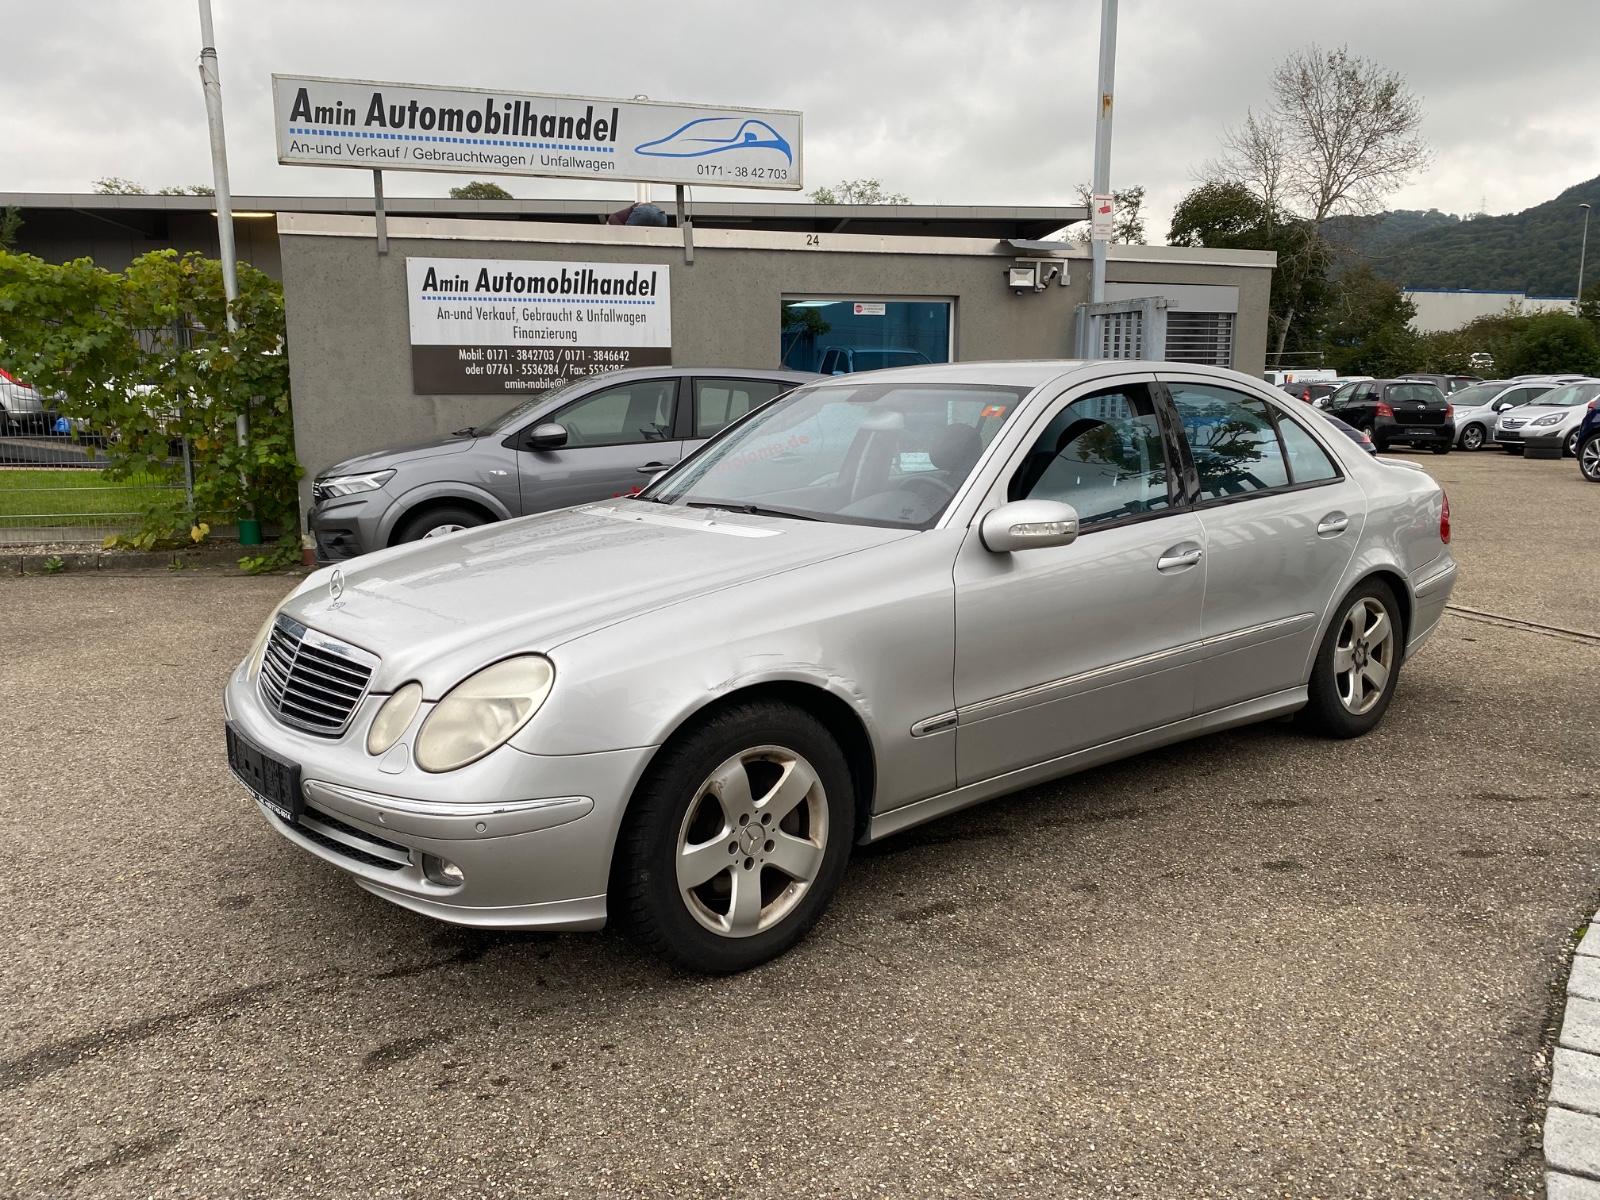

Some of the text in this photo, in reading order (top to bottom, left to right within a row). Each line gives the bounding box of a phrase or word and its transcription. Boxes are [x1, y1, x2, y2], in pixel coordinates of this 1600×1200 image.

[289, 87, 619, 142] Amin Automobilhandel
[290, 140, 342, 155] An-und
[346, 143, 401, 159] Verkauf
[412, 147, 526, 167] Gebrauchtwagen
[540, 155, 615, 172] Unfallwagen
[696, 164, 723, 176] 0171
[734, 167, 748, 178] 38
[751, 167, 764, 179] 42
[767, 168, 788, 180] 703
[806, 234, 820, 246] 24
[421, 266, 657, 297] Amin Automobilhandel
[436, 305, 647, 326] An-und Verkauf, Gebraucht & Unfallwagen
[512, 326, 578, 342] Finanzierung
[458, 348, 485, 361] Mobil:
[486, 349, 508, 361] 0171
[516, 349, 555, 361] 3842703
[564, 350, 585, 361] 0171
[593, 350, 630, 362] 3846642
[465, 362, 484, 375] oder
[486, 363, 513, 375] 07761
[521, 363, 559, 375] 5536284
[569, 364, 587, 375] Fax:
